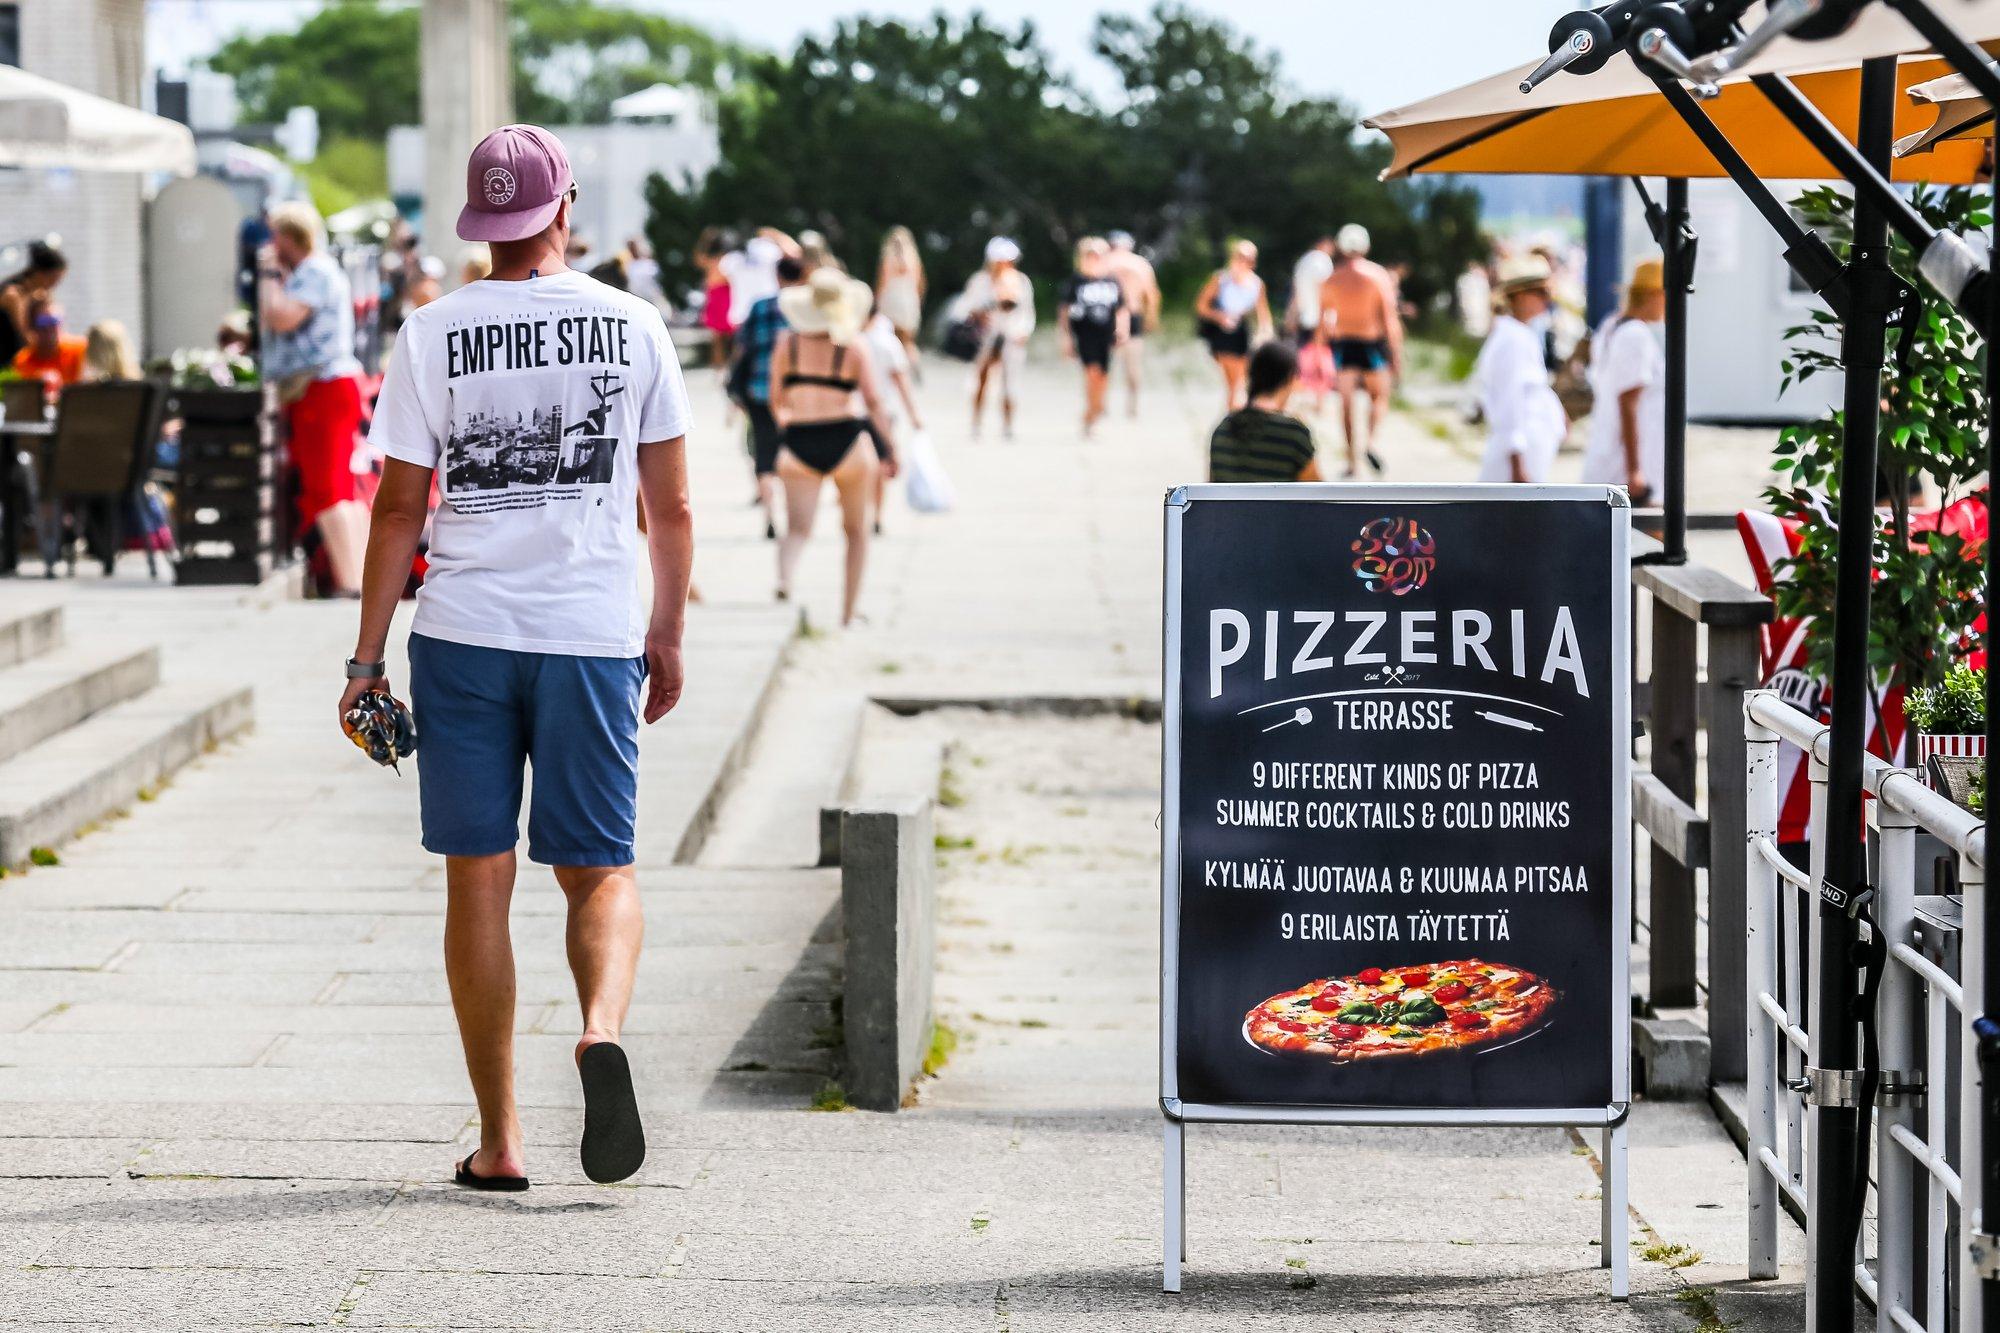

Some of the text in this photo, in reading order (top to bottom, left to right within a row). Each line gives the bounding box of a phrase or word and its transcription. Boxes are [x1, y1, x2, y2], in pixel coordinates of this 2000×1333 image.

[446, 316, 630, 379] EMPIRE STATE
[1209, 605, 1591, 700] PIZZERIA
[1402, 673, 1421, 681] 2017
[1332, 699, 1454, 731] TERRASSE
[1252, 761, 1539, 790] 9 DIFFERENT KINDS OF PIZZA
[1216, 799, 1570, 829] SUMMER COCKTAILS & COLD DRINKS
[1205, 858, 1589, 893] KYLMÄÄ JUOTAVAA & KUUMAA PITSAA
[1280, 908, 1510, 941] 9 ERILAISTA TÄYTETTÄ
